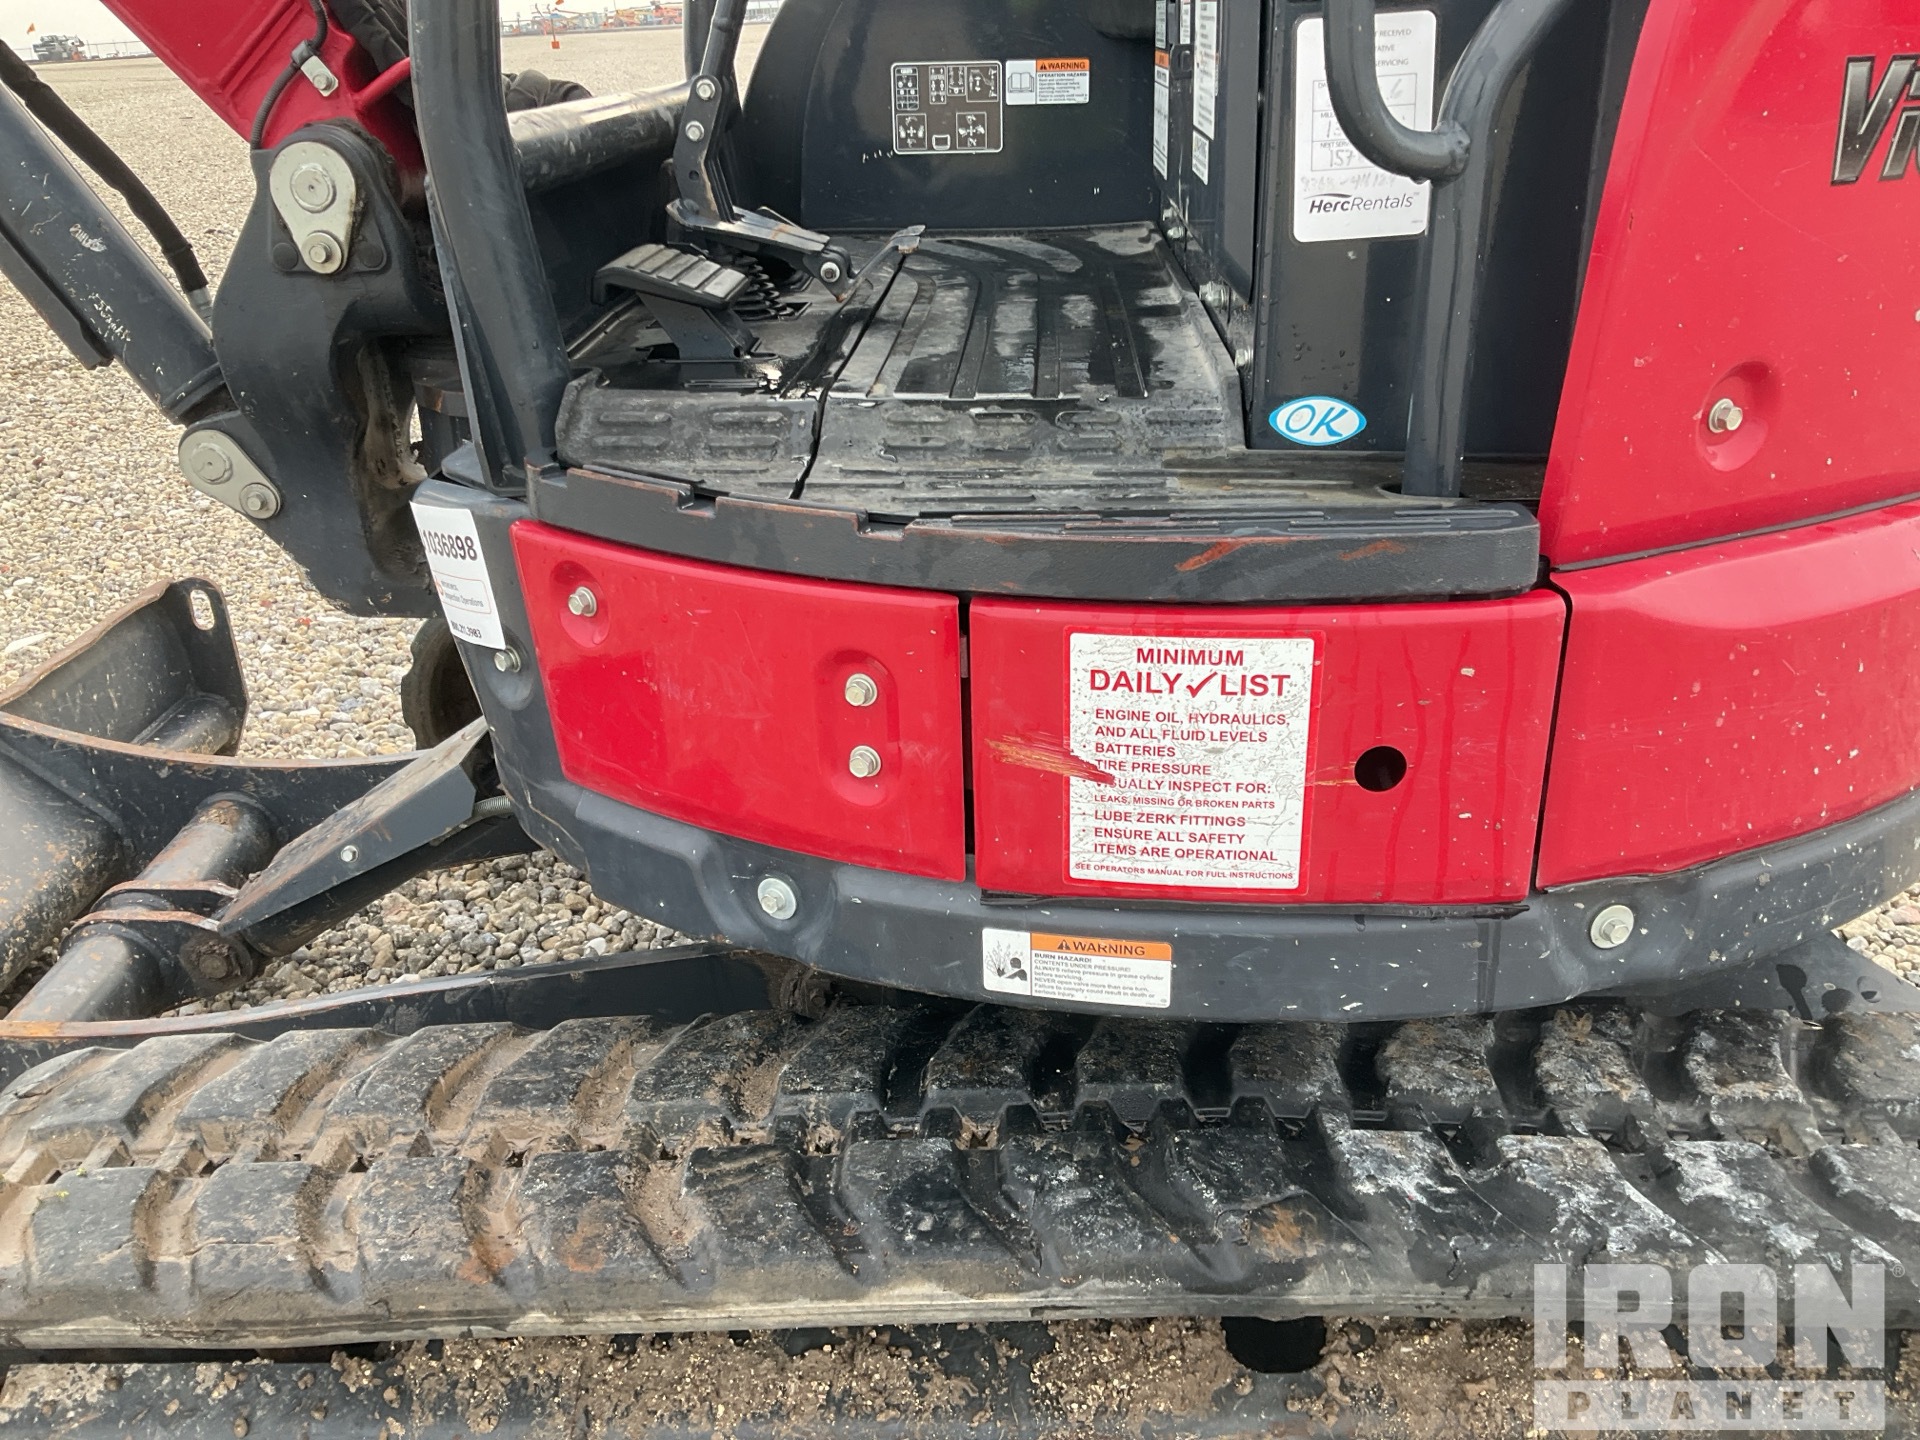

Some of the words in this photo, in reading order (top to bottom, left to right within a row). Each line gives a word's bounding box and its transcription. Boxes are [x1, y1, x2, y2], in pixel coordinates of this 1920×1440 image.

[1286, 405, 1348, 437] OK
[1137, 648, 1244, 666] MINIMUM
[1090, 670, 1182, 694] DAILY
[1221, 675, 1290, 696] LIST
[1096, 709, 1150, 722] ENGINE
[1156, 712, 1183, 725] OIL,
[1189, 713, 1289, 726] HYDRAULICS,
[1095, 726, 1126, 738] AND
[1130, 728, 1157, 740] ALL
[1163, 729, 1205, 741] FLUID
[1210, 731, 1268, 742] LEVELS
[1095, 743, 1175, 757] BATTERIES
[1097, 760, 1127, 771] TIRE
[1132, 762, 1211, 775] PRESSURE
[1168, 781, 1231, 793] INSPECT
[1236, 782, 1271, 793] FOR:
[1095, 795, 1130, 805] LEAKS,
[1133, 797, 1175, 806] MISSING
[1178, 798, 1192, 806] OR
[1196, 799, 1239, 808] BROKEN
[1242, 801, 1275, 809] PARTS
[1094, 810, 1132, 822] LUBE
[1136, 812, 1175, 824] ZERK
[1180, 814, 1246, 827] FITTINGS
[1094, 828, 1152, 840] ENSURE
[1157, 831, 1184, 842] ALL
[1189, 833, 1245, 844] SAFETY
[1094, 844, 1136, 856] ITEMS
[1140, 847, 1170, 857] ARE
[1174, 848, 1278, 861] OPERATIONAL
[1094, 865, 1145, 874] OPERATORS
[1073, 941, 1145, 956] WARNING
[1034, 959, 1068, 967] CONTENTS
[1094, 964, 1131, 972] PRESSURE!
